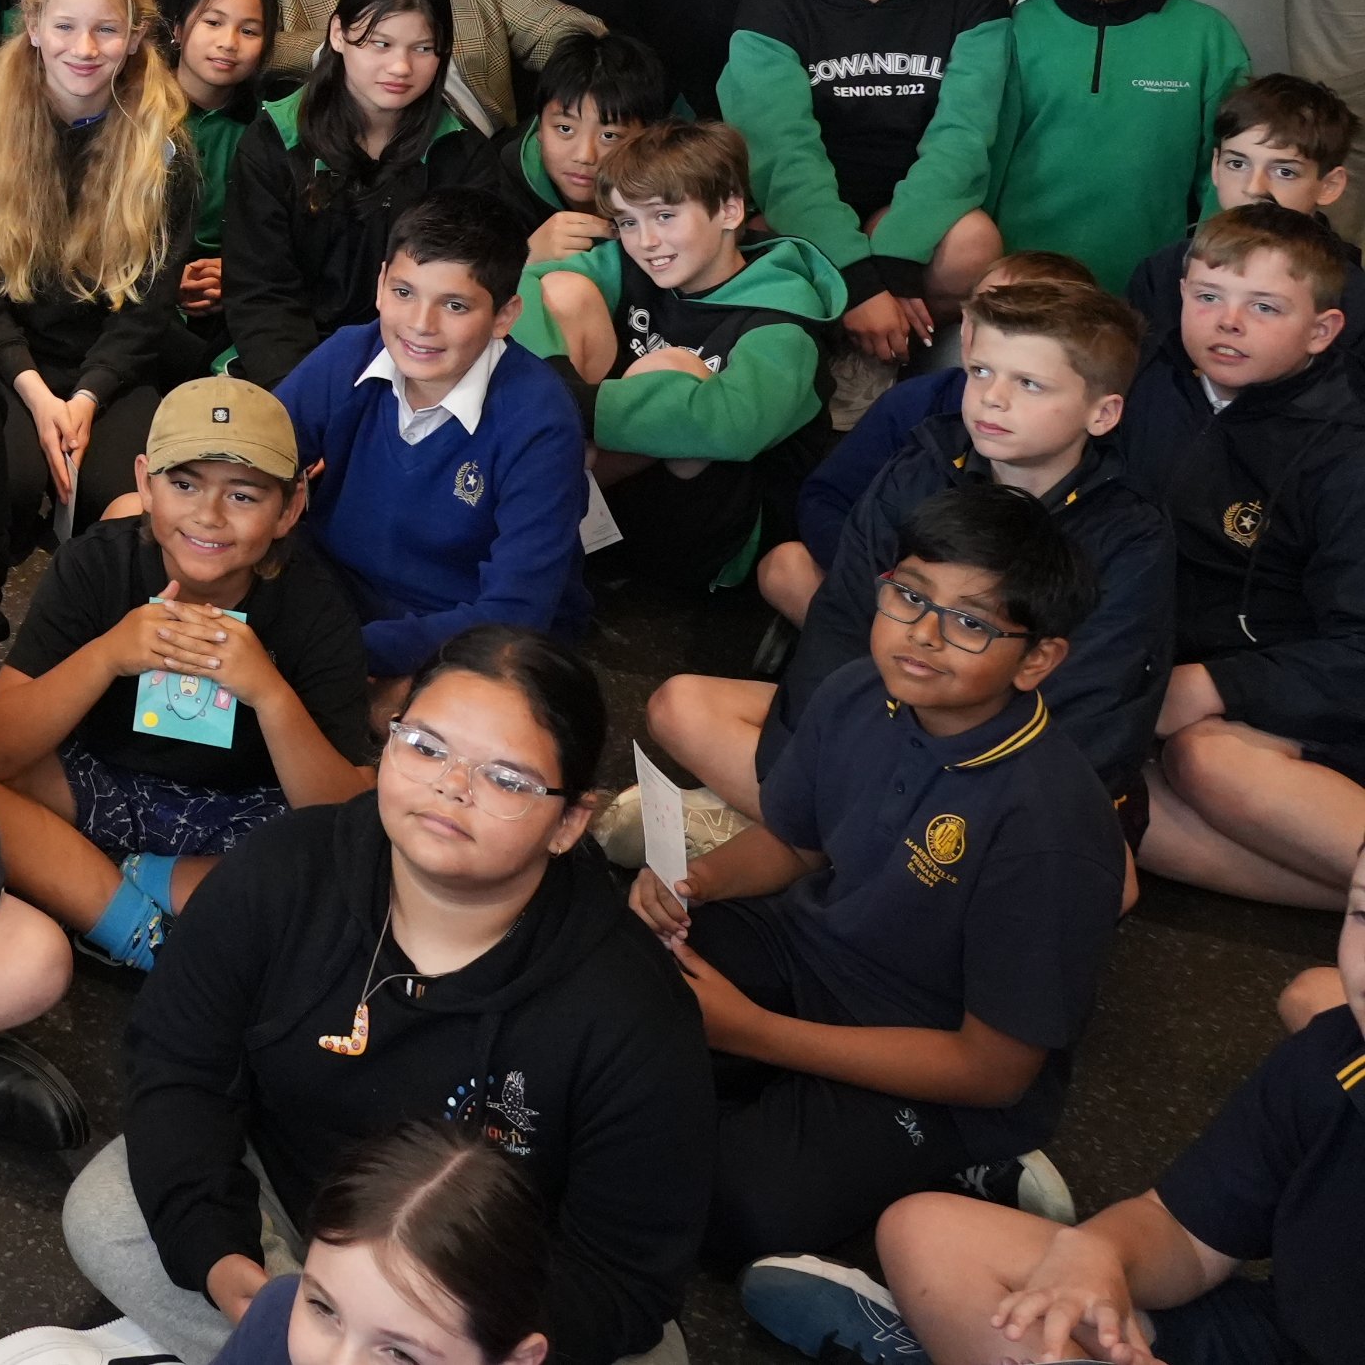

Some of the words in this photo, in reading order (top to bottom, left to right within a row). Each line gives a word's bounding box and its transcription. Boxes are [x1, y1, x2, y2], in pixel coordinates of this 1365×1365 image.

[1131, 79, 1191, 88] COWANDILLA
[832, 85, 892, 97] SENIORS
[895, 83, 925, 96] 2022
